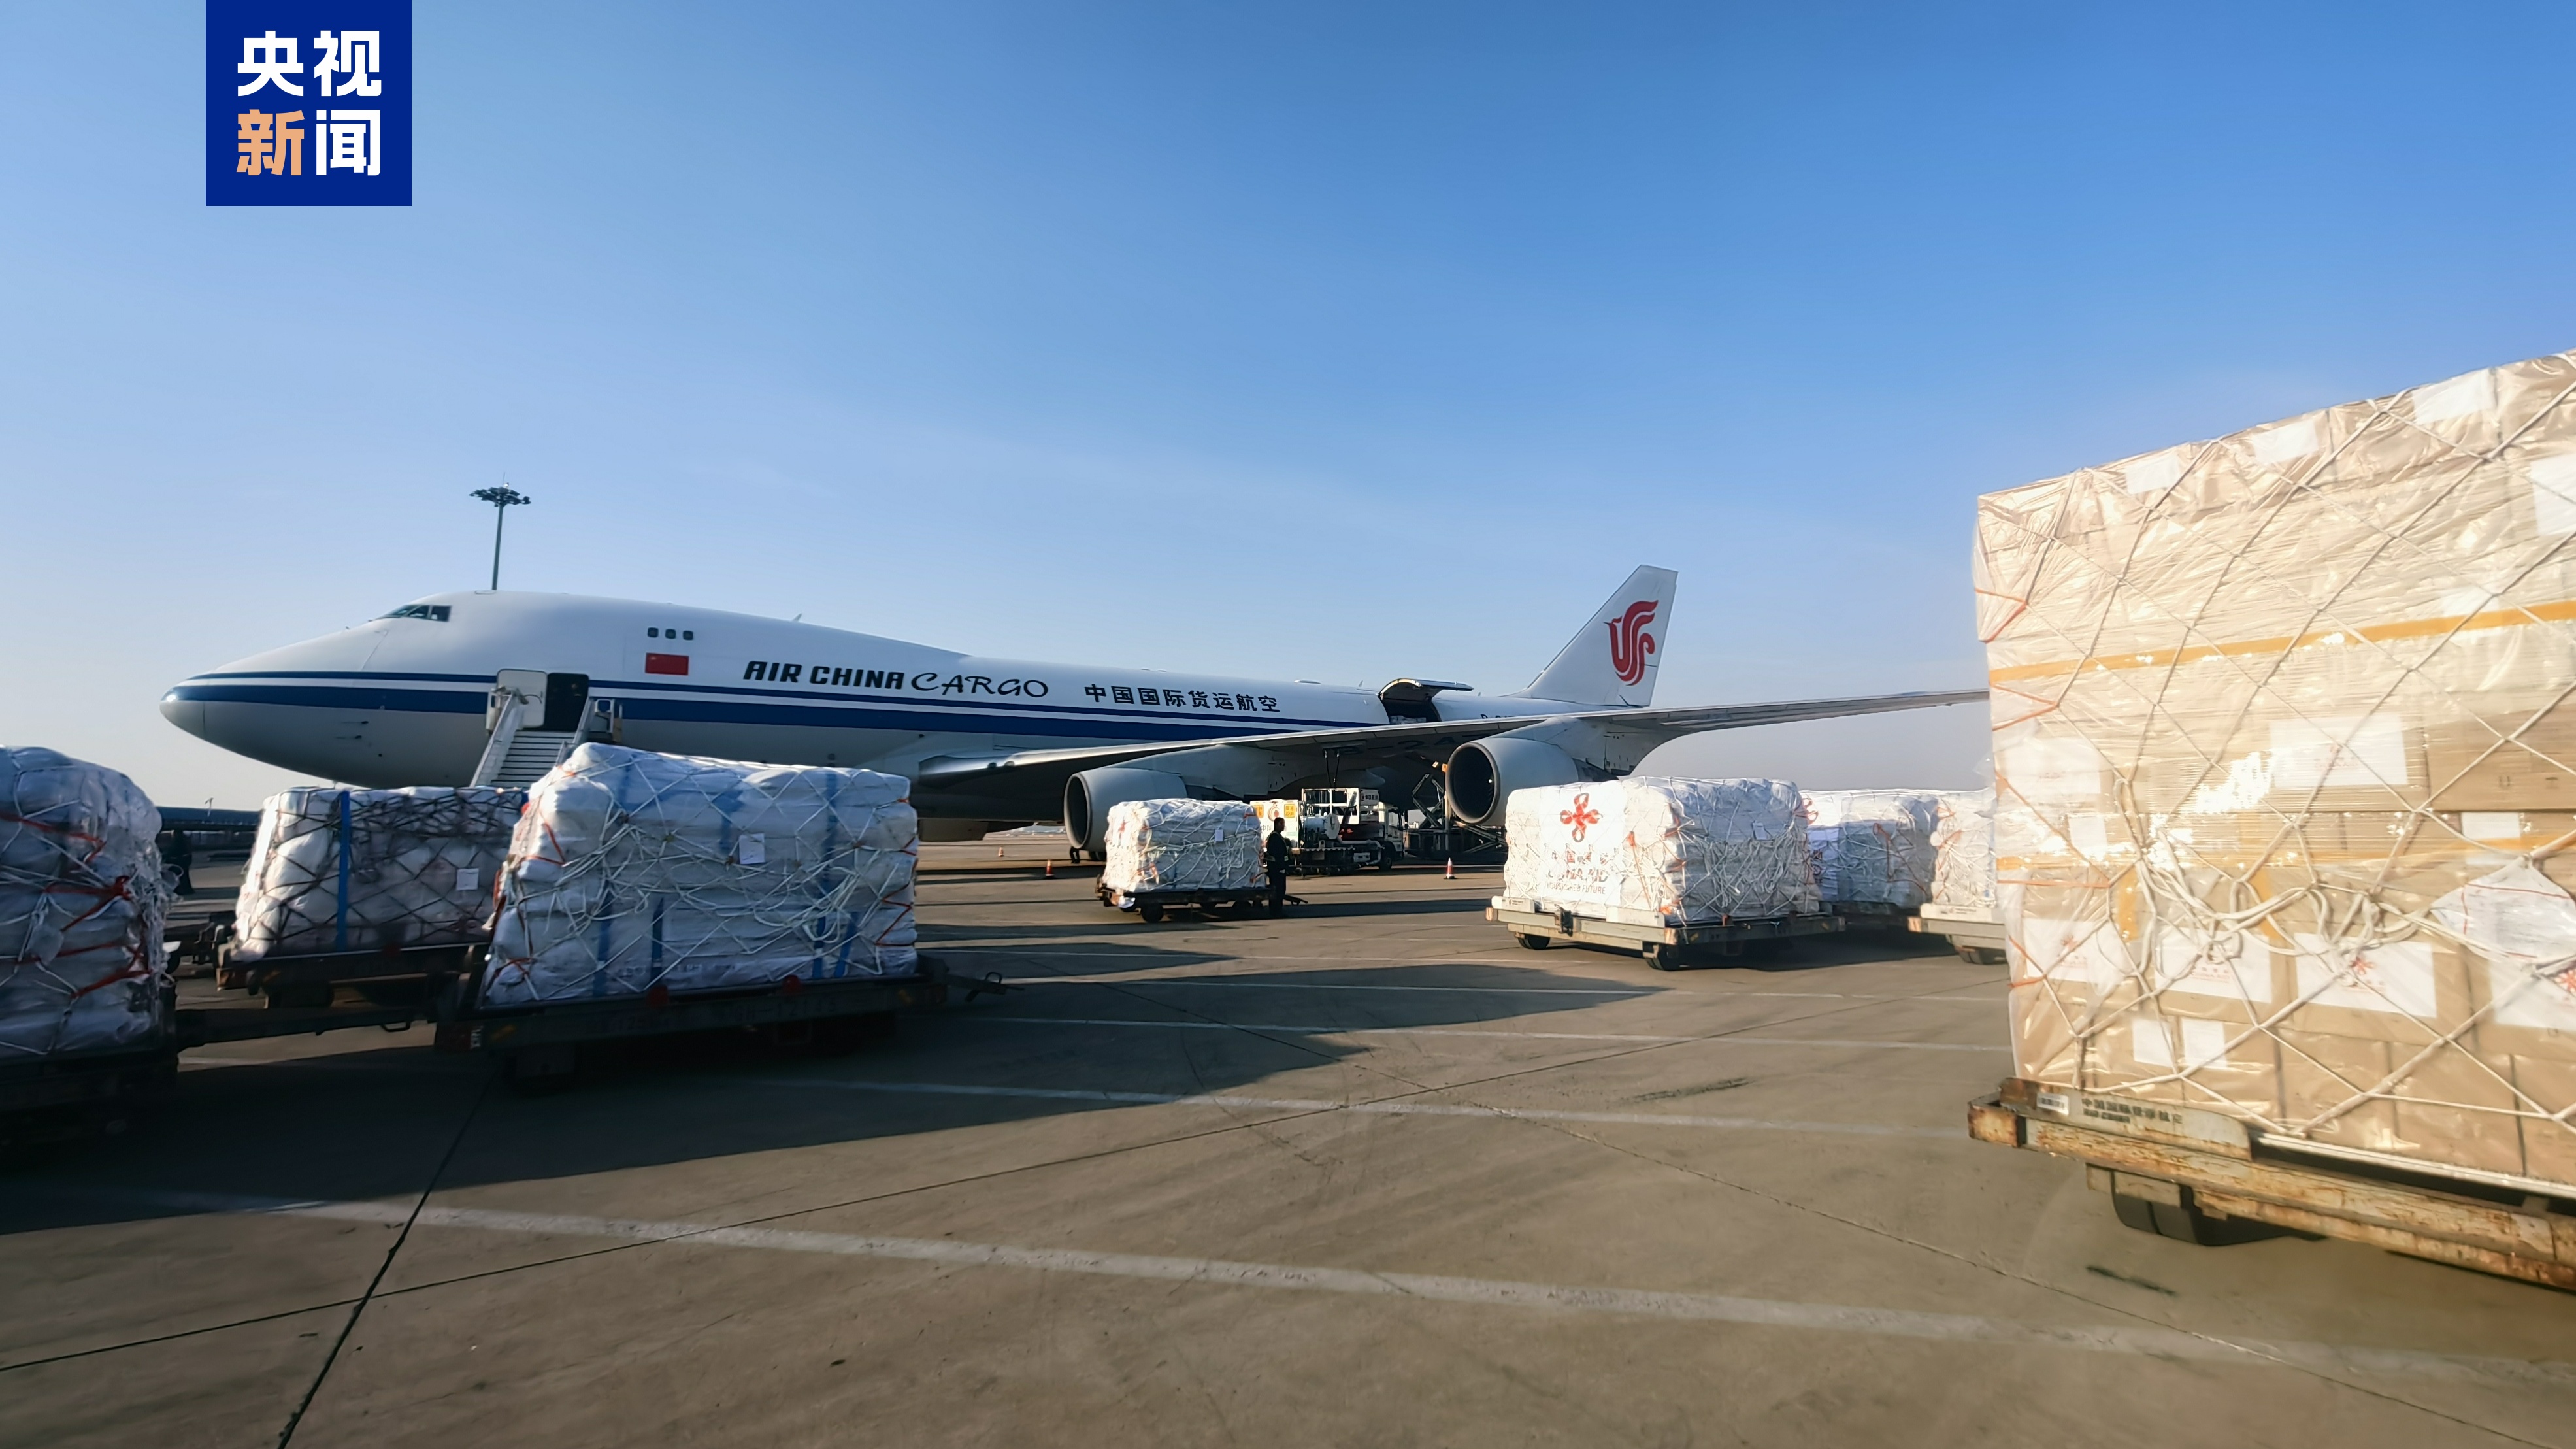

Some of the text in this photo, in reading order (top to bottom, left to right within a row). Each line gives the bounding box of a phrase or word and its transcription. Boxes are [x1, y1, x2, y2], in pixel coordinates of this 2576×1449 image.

[743, 661, 1049, 698] AIR CHINA CARGO
[1084, 684, 1280, 712] 中国国际货运航空
[1582, 884, 1606, 894] FUTURE
